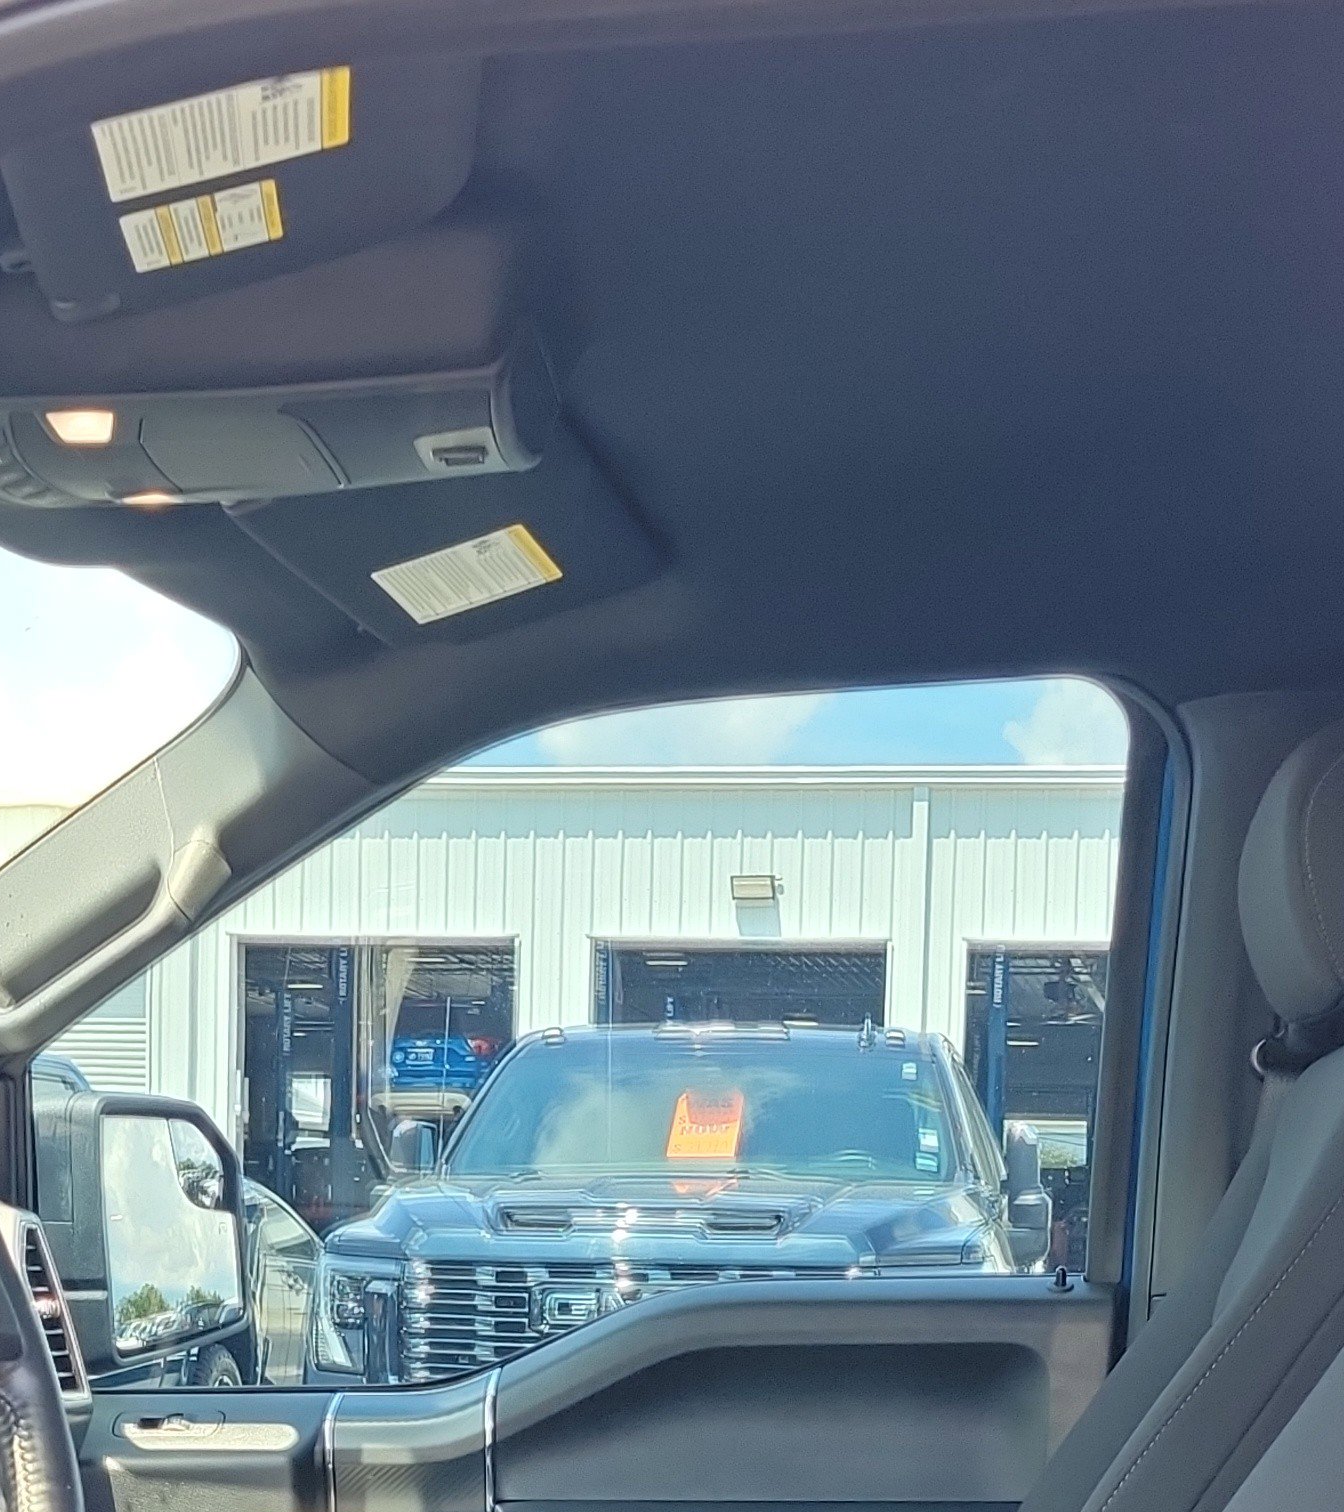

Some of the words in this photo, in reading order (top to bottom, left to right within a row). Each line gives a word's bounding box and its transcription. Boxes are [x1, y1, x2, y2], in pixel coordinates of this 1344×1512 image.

[339, 959, 348, 996] ROTARY
[992, 962, 1004, 1003] ROTARY
[283, 993, 292, 1013] LIFT
[283, 1015, 292, 1052] ROTARY
